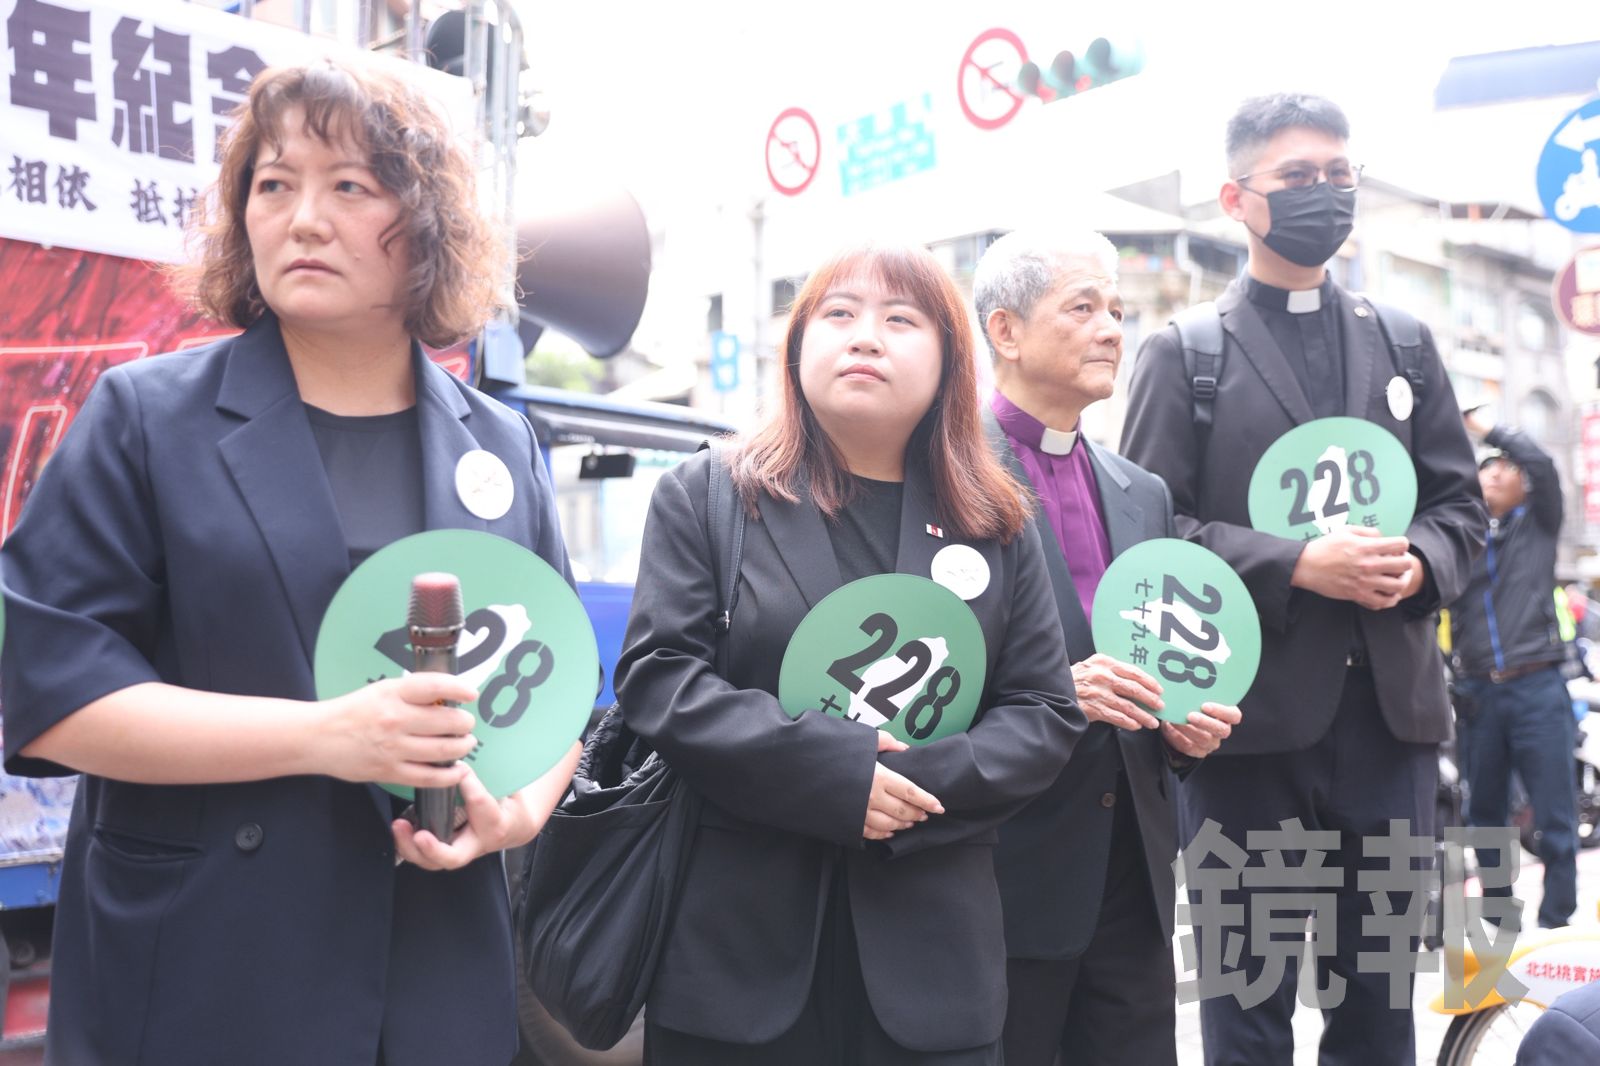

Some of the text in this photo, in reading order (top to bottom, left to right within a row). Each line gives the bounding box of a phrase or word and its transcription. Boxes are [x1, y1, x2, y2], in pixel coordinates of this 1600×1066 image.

[8, 155, 97, 211] 相依
[1280, 450, 1380, 526] 228
[1130, 578, 1153, 665] 七十九年
[1158, 574, 1222, 689] 228
[826, 613, 961, 740] 228
